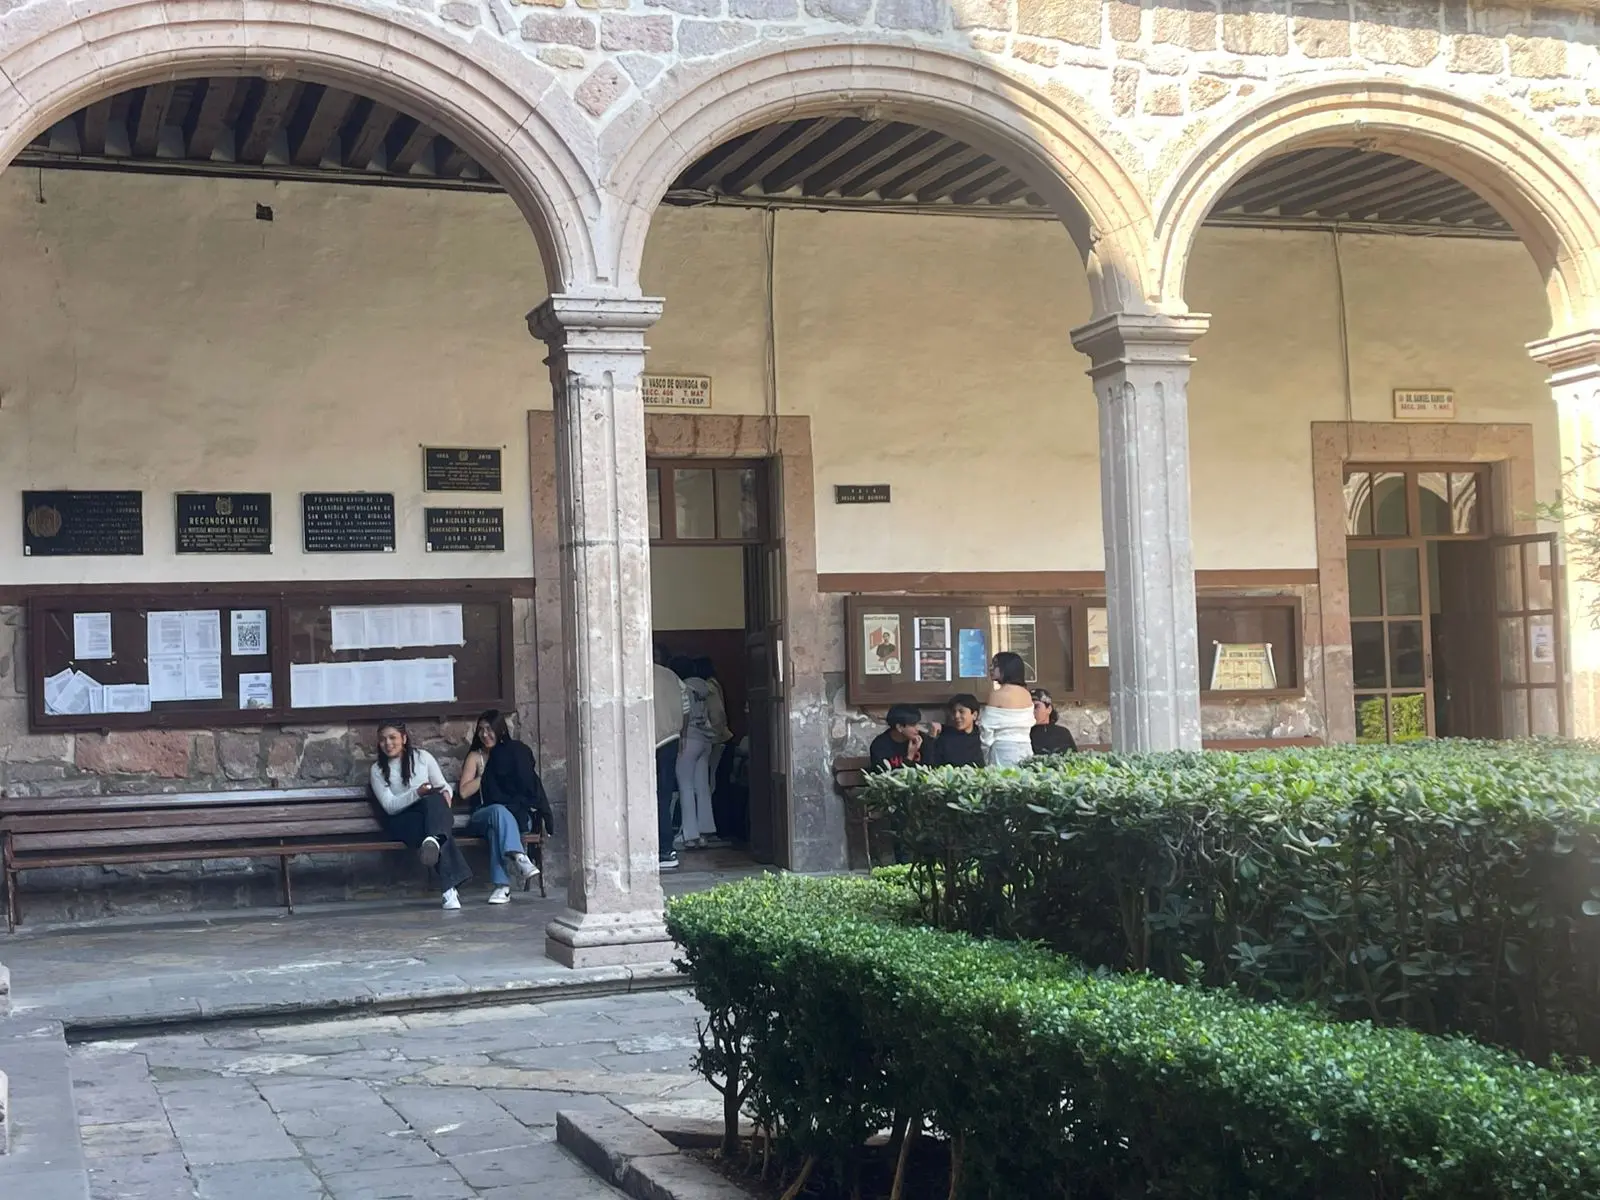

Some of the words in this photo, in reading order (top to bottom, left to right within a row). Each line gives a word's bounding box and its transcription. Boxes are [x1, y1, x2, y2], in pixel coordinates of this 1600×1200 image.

[649, 379, 666, 388] VASCO
[667, 379, 674, 389] DE
[675, 380, 698, 389] QUIROGA
[189, 516, 259, 525] RECONOCIMIENTO
